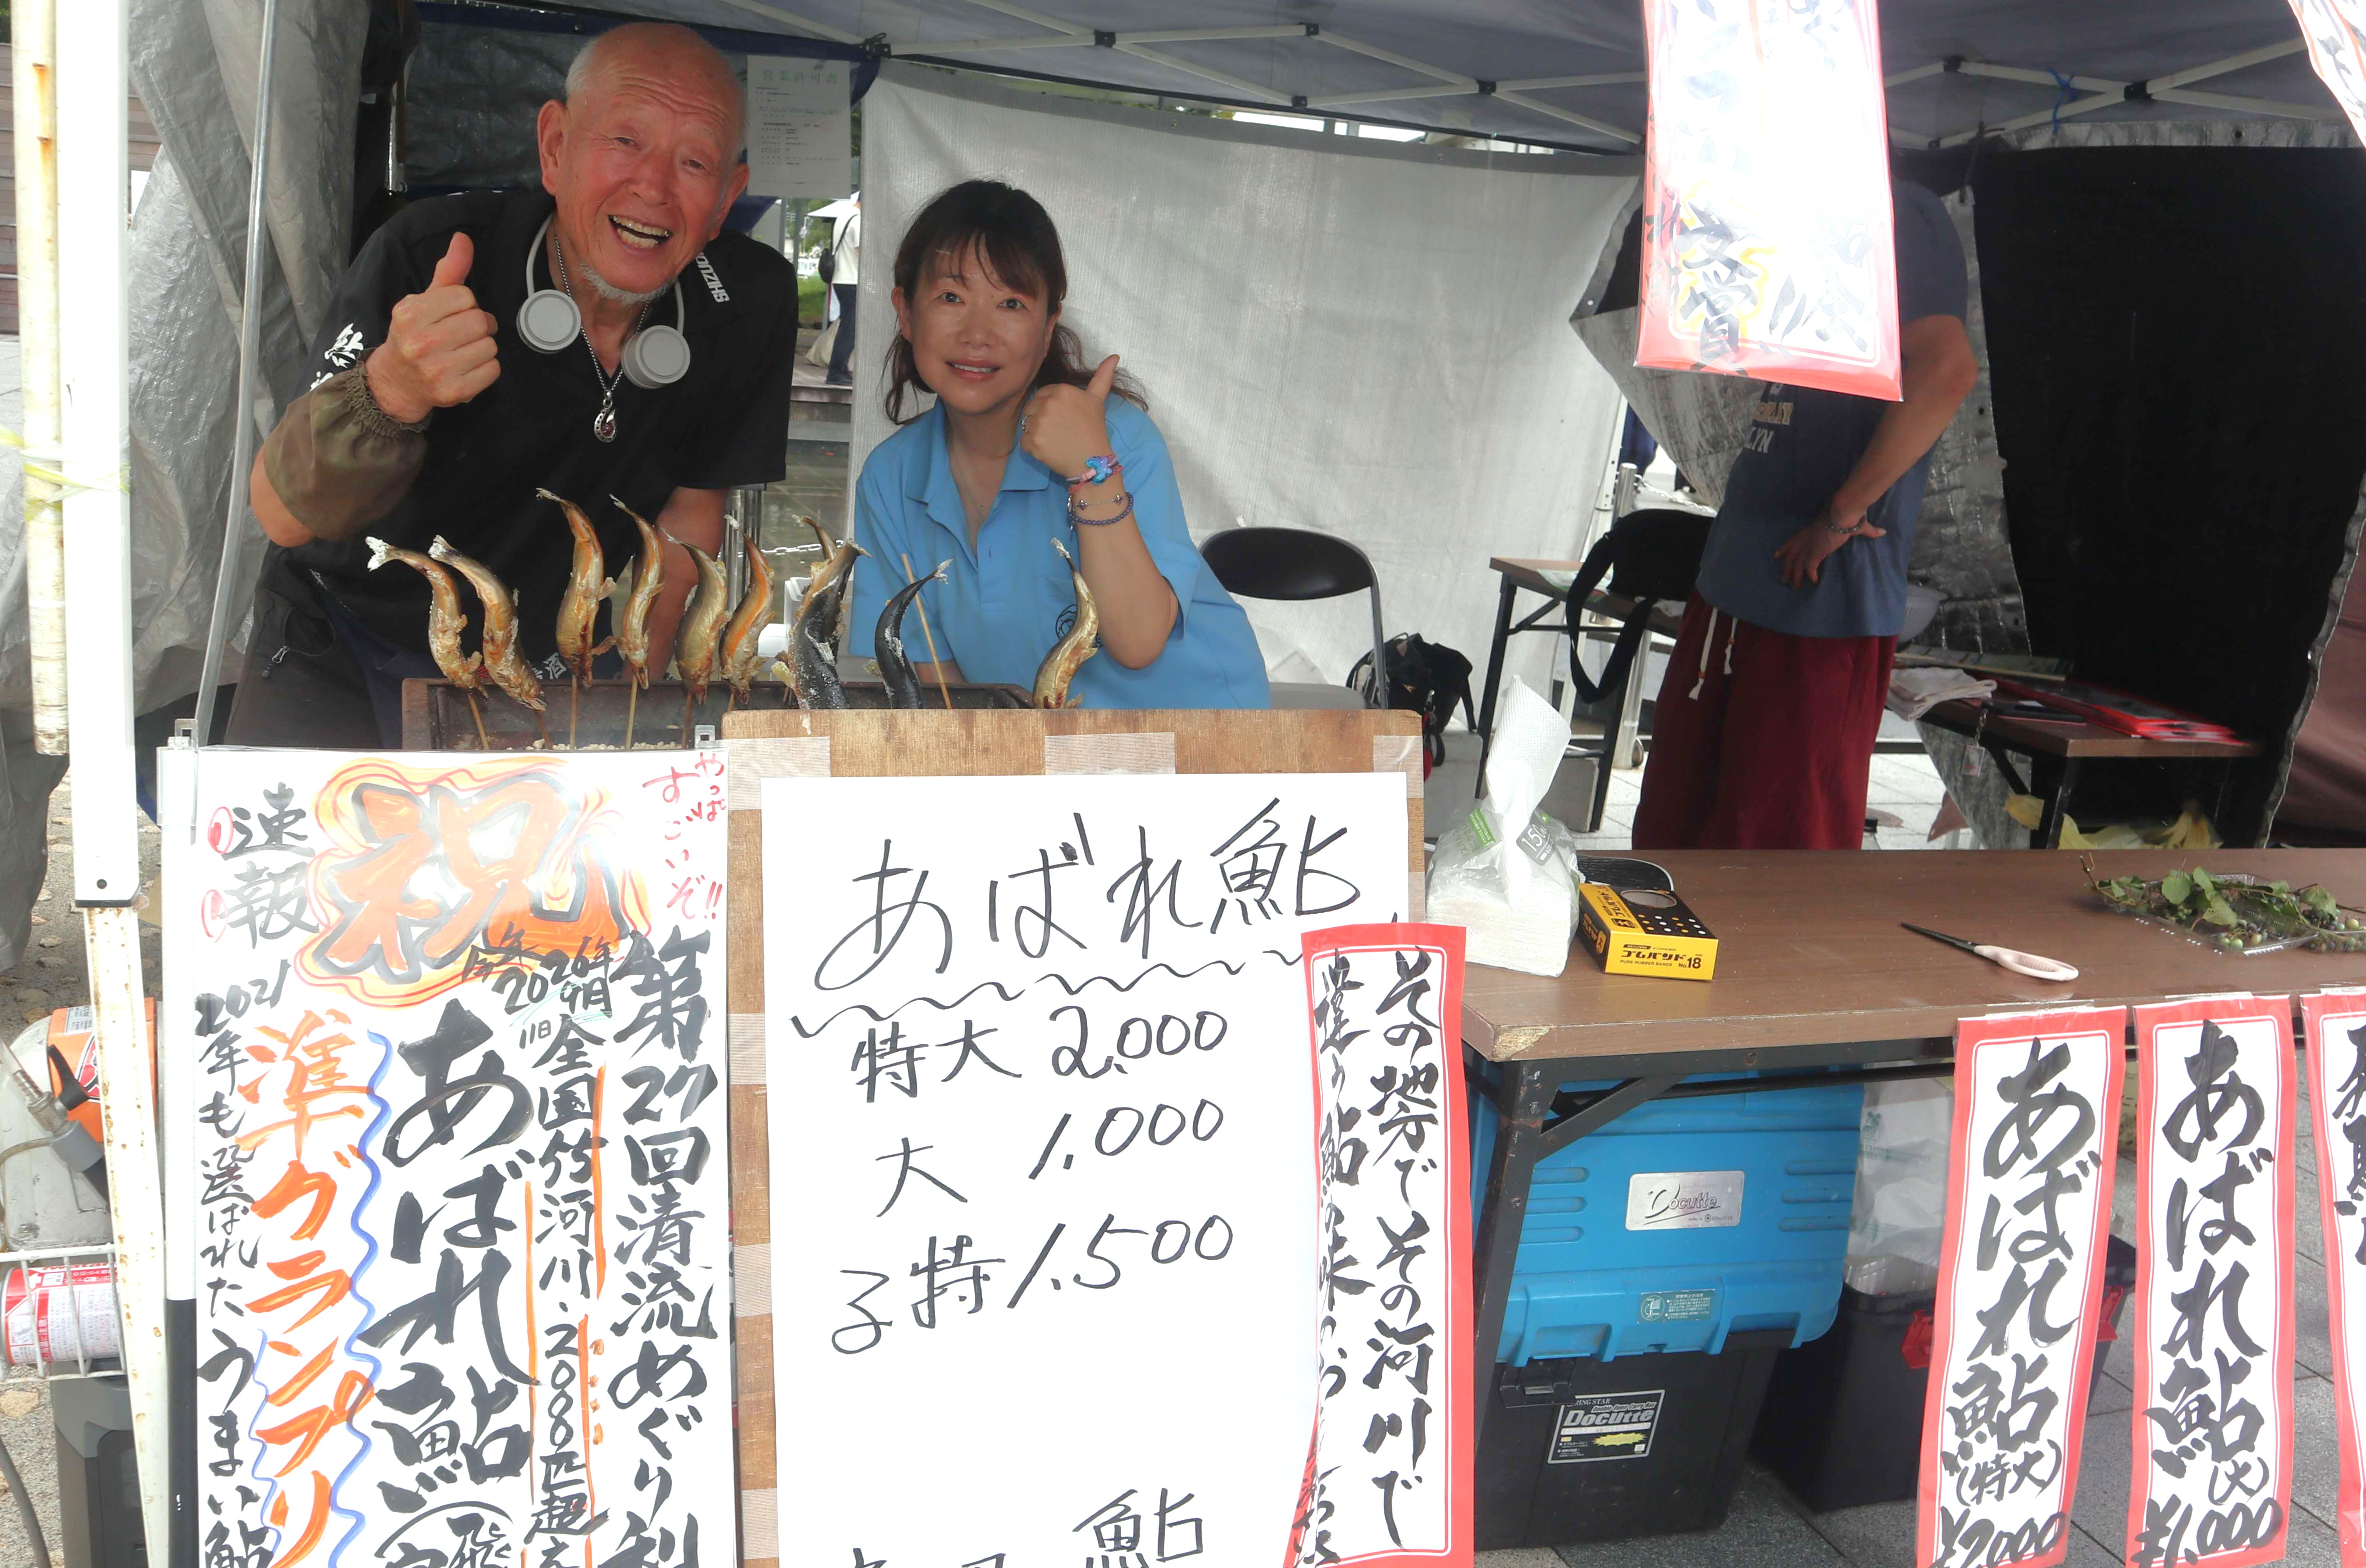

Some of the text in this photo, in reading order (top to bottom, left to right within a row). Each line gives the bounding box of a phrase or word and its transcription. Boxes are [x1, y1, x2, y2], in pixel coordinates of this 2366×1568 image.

[220, 782, 321, 950] 速報
[815, 798, 1361, 991] あばれ鮎
[1621, 950, 1687, 961] ゴムバンド
[851, 1020, 1022, 1103] 特大
[358, 999, 542, 1512] あばれ鮎
[876, 1138, 967, 1217] 大
[1941, 1037, 2102, 1476] あばれ鮎
[2143, 1020, 2274, 1478] あばれ鮎
[1563, 1409, 1655, 1427] Docutte
